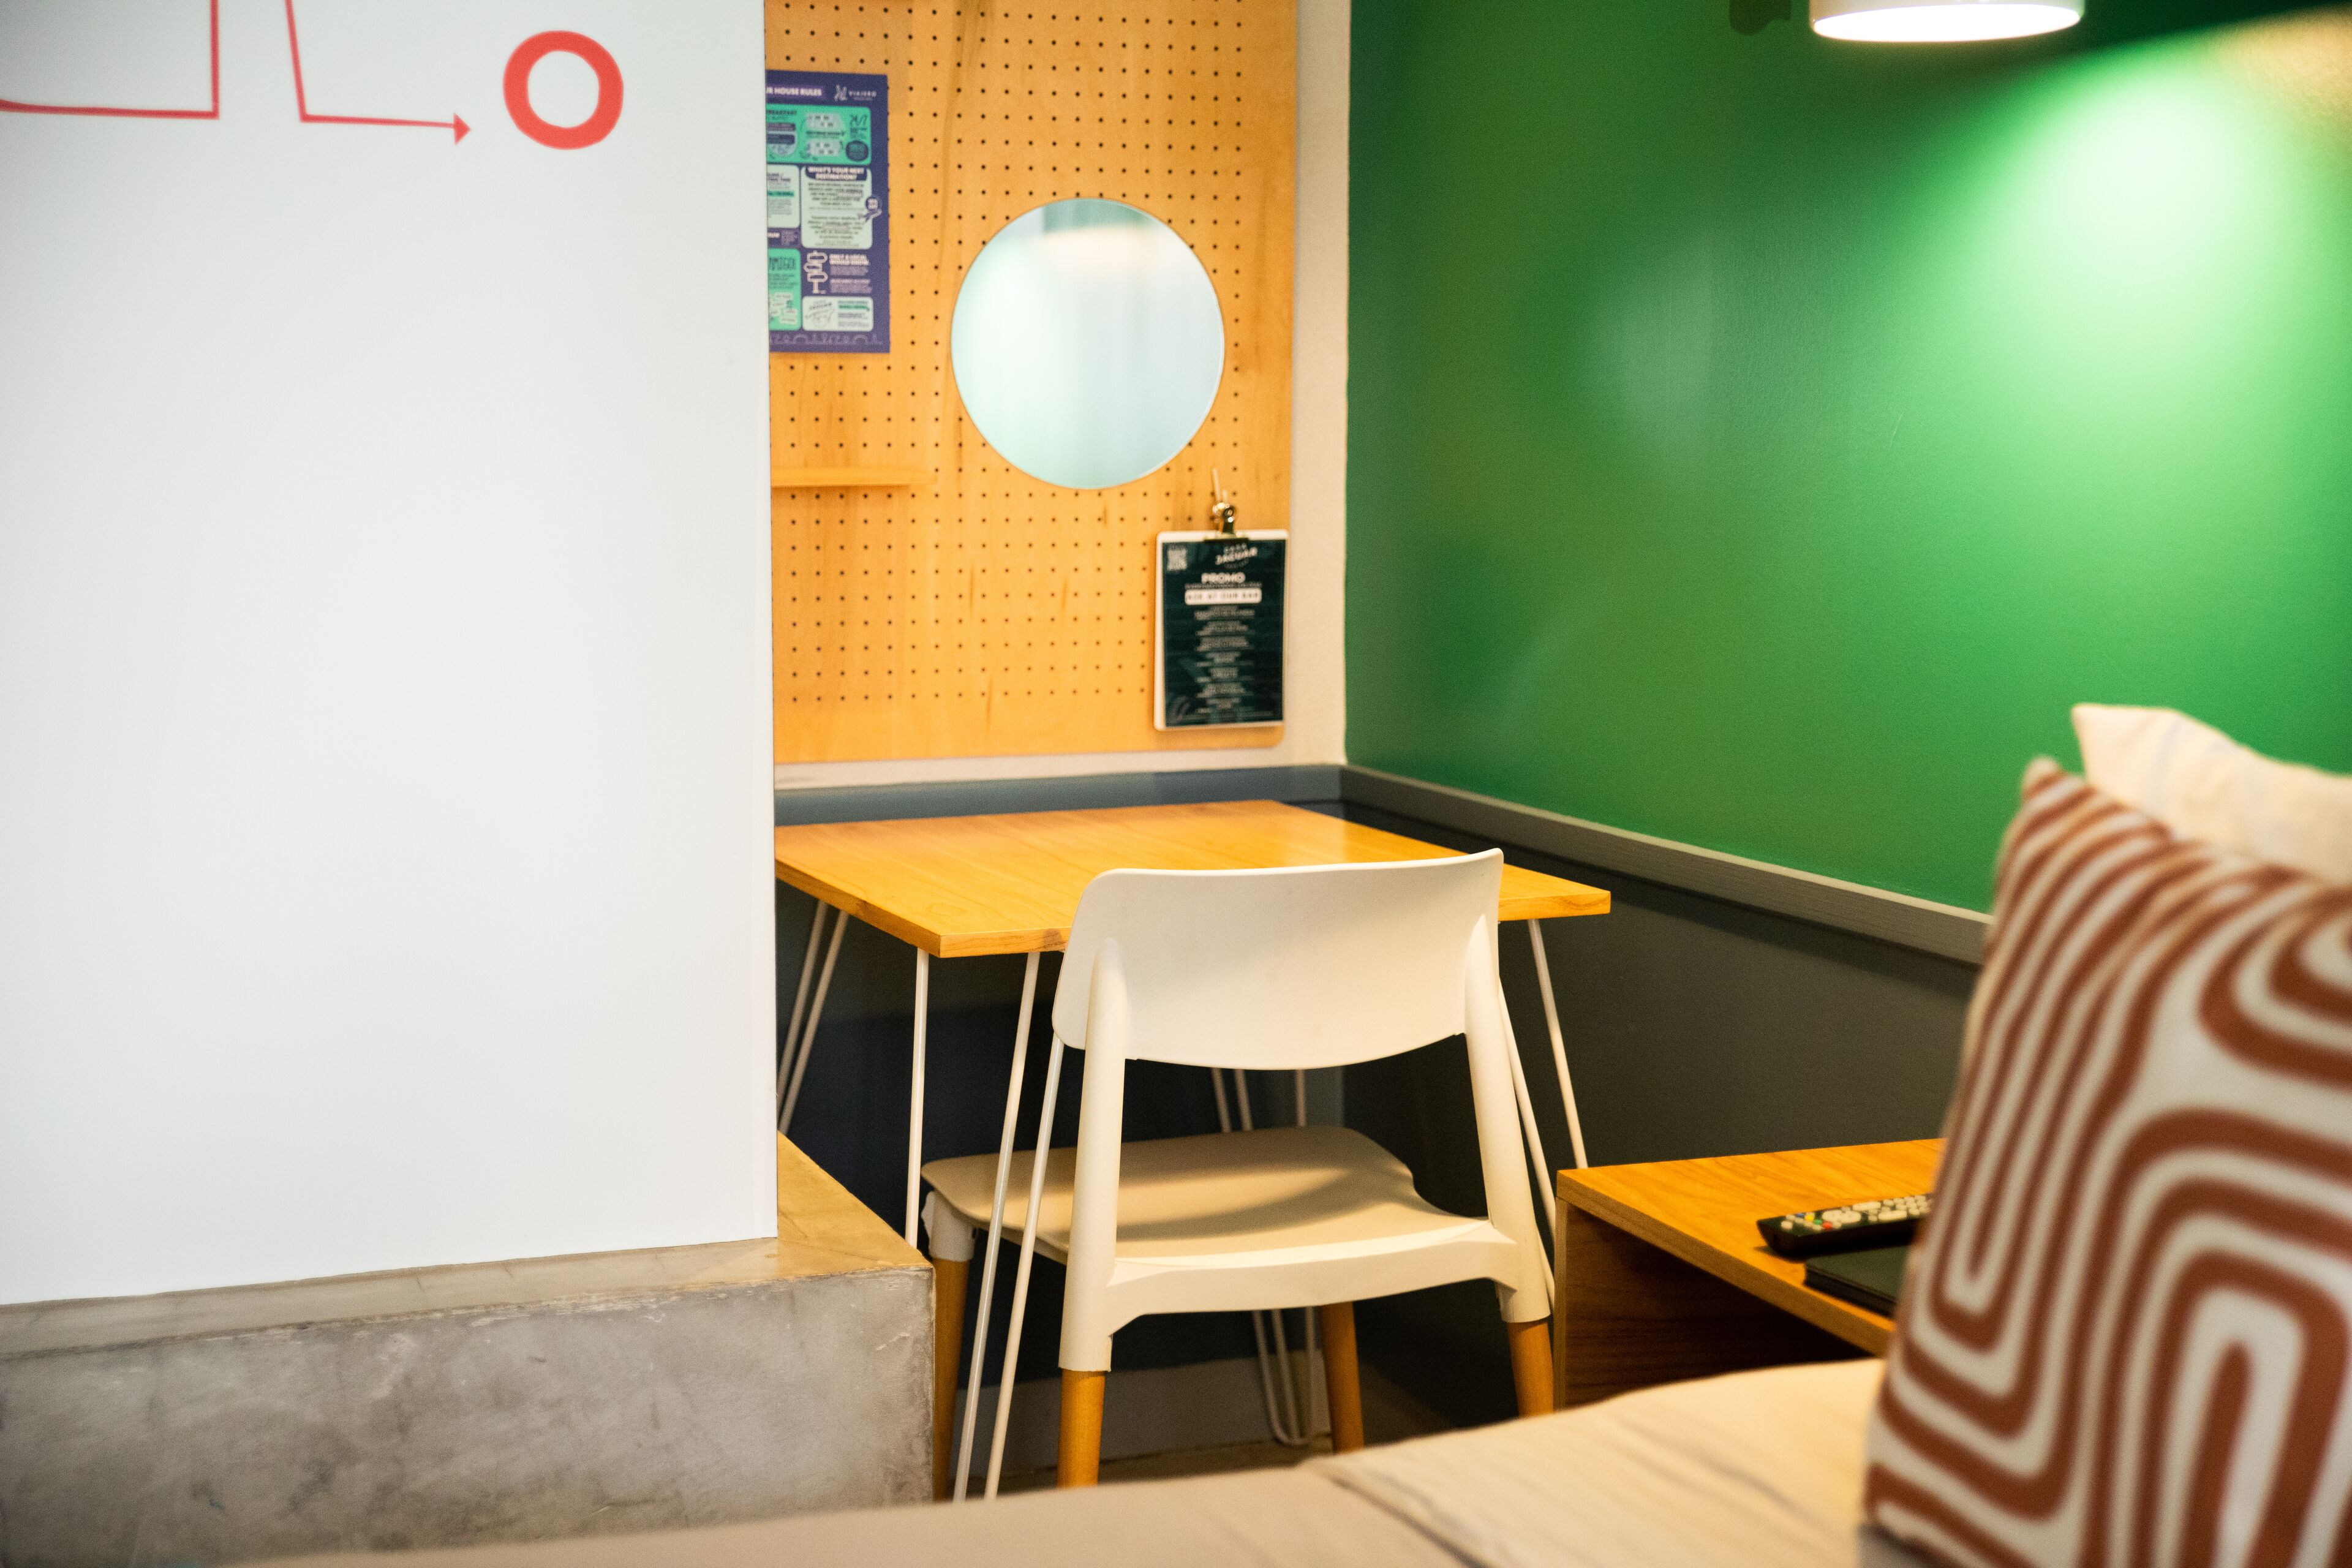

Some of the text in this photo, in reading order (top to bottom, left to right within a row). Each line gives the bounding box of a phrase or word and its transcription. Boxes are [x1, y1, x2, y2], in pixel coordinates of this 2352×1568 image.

[774, 87, 799, 96] HOUSE
[800, 88, 822, 97] RULES
[1215, 546, 1258, 565] JAGUAR
[1201, 571, 1246, 584] PROMO
